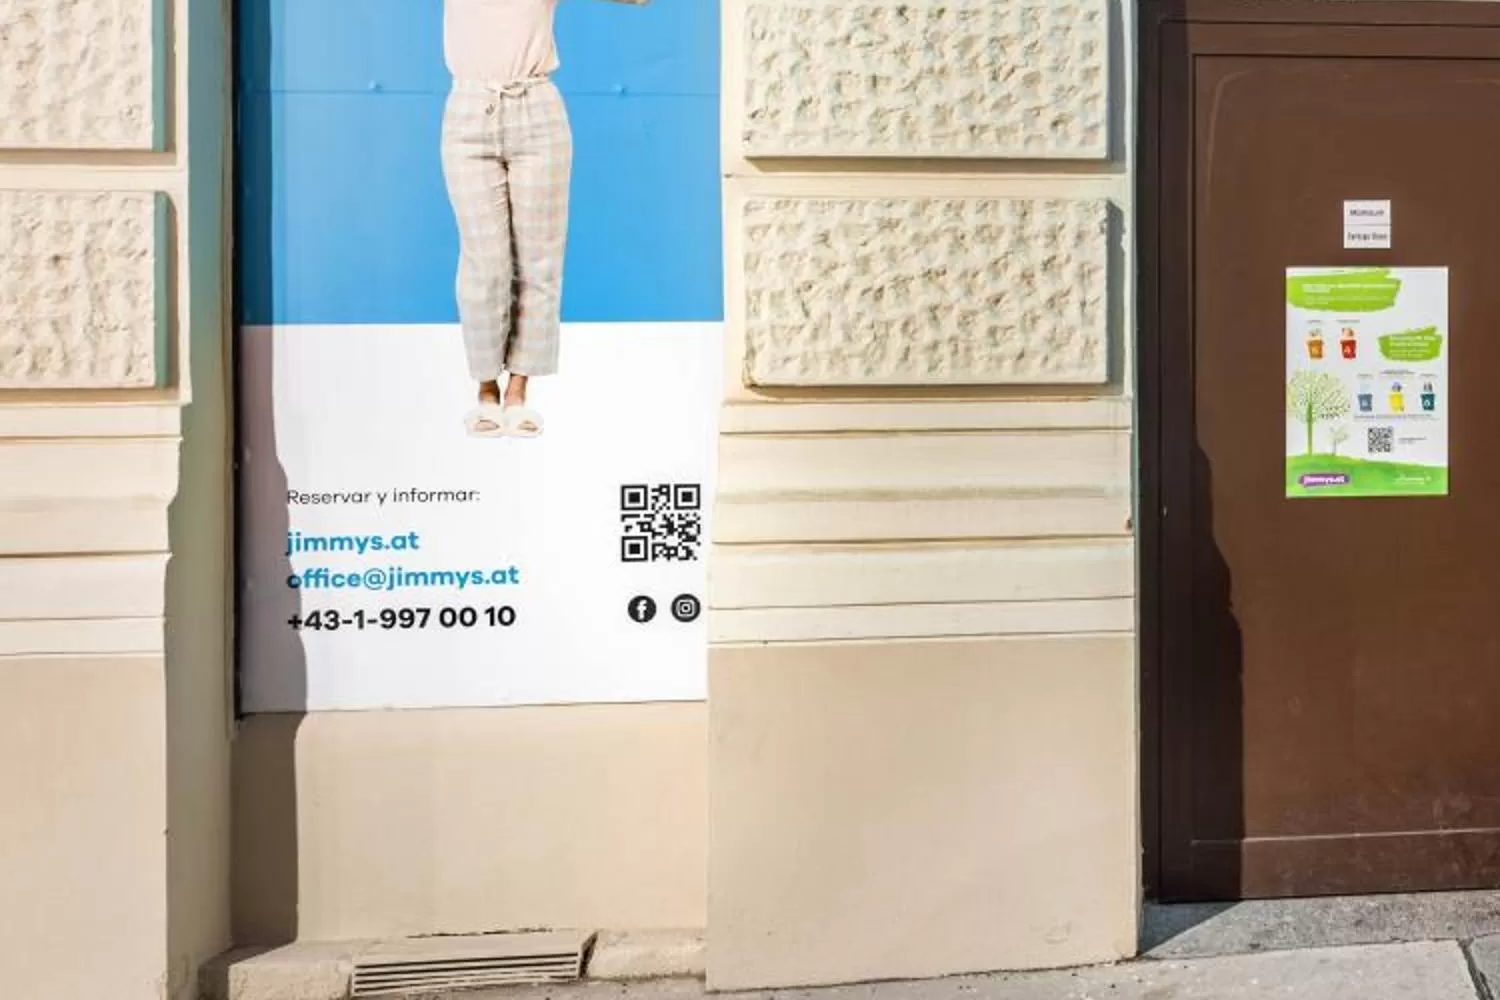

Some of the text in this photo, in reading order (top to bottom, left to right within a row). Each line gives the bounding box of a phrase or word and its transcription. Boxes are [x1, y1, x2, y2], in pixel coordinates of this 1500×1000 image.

[287, 488, 481, 505] Reservar y informar:
[286, 532, 420, 556] jimmys.at
[286, 565, 520, 591] office@jimmys.at
[287, 605, 516, 631] +43-1-997 00 10
